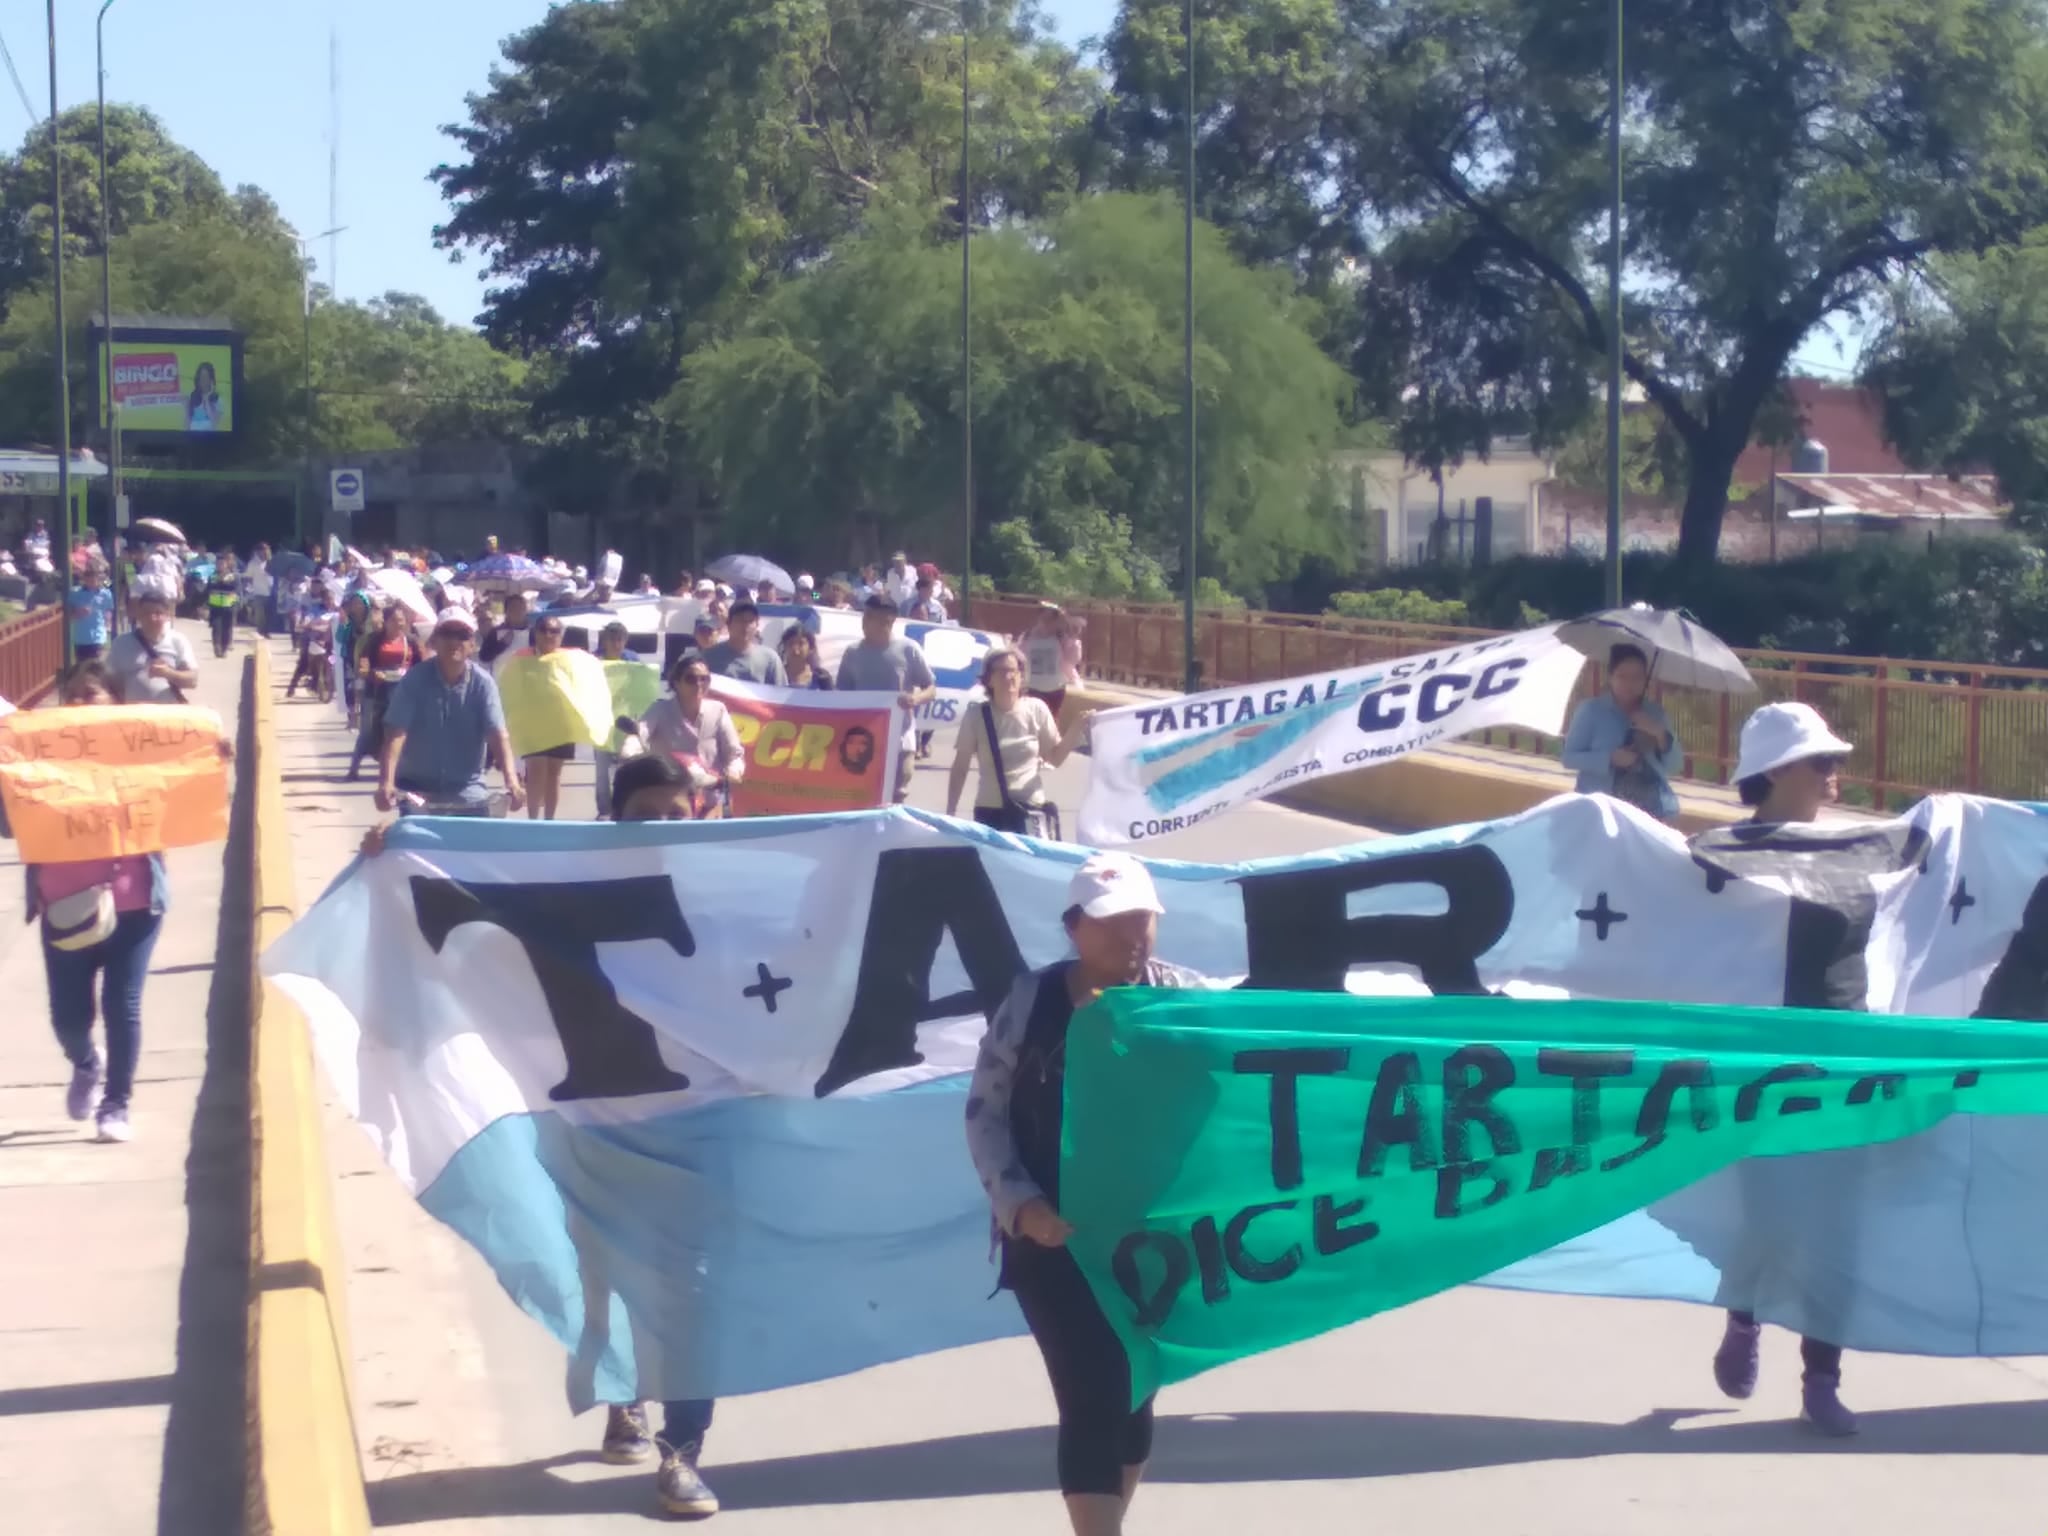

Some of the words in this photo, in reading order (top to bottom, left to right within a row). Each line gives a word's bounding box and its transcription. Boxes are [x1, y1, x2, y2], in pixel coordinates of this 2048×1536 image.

[114, 362, 178, 386] BINGO
[1135, 679, 1353, 736] TARTAGAL
[1356, 656, 1529, 733] CCC
[732, 712, 835, 772] PCR
[1233, 1045, 1981, 1191] TARTAG
[1112, 1192, 1381, 1329] DICE
